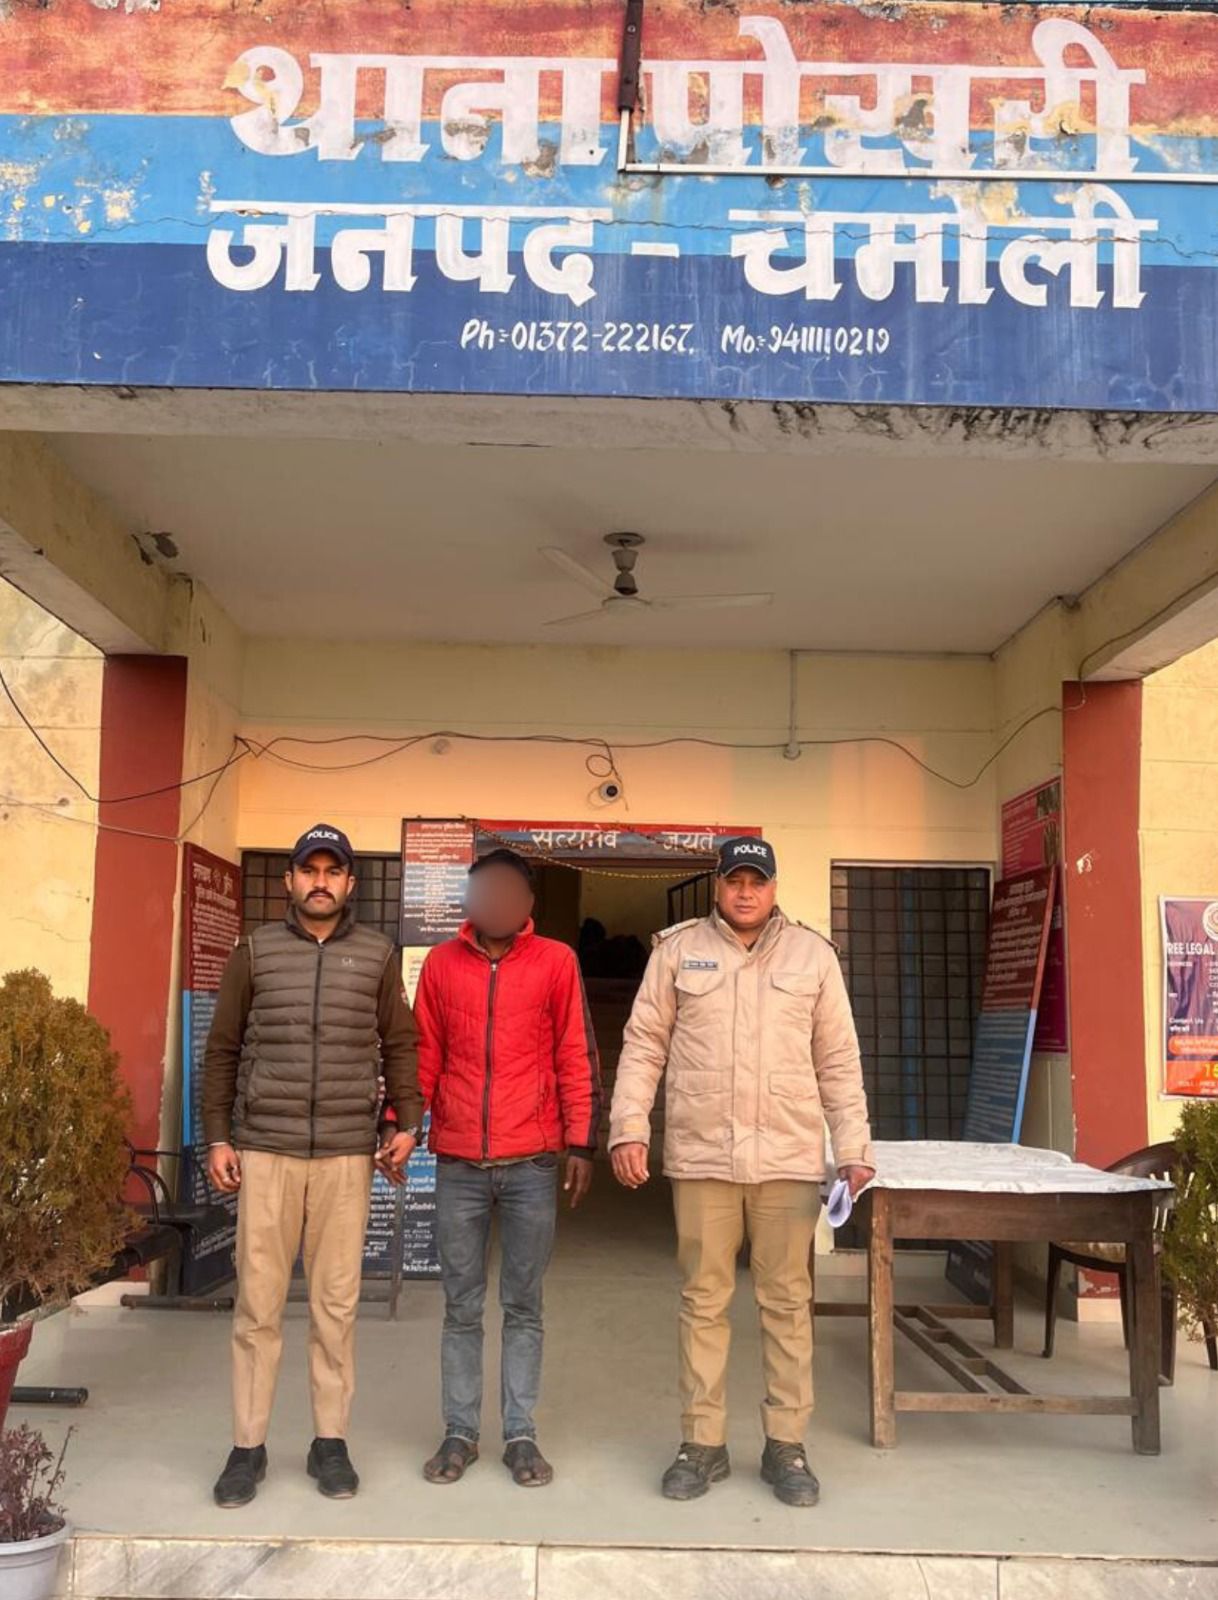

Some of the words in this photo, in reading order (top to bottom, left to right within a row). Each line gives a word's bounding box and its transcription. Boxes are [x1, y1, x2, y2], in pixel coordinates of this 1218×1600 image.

[222, 45, 618, 163] थाना
[206, 199, 613, 306] जनपद
[728, 182, 1159, 309] चमोली
[307, 830, 339, 841] POLICE
[733, 843, 767, 858] POLICE
[1167, 942, 1185, 956] REE
[1185, 942, 1216, 956] LEGAL
